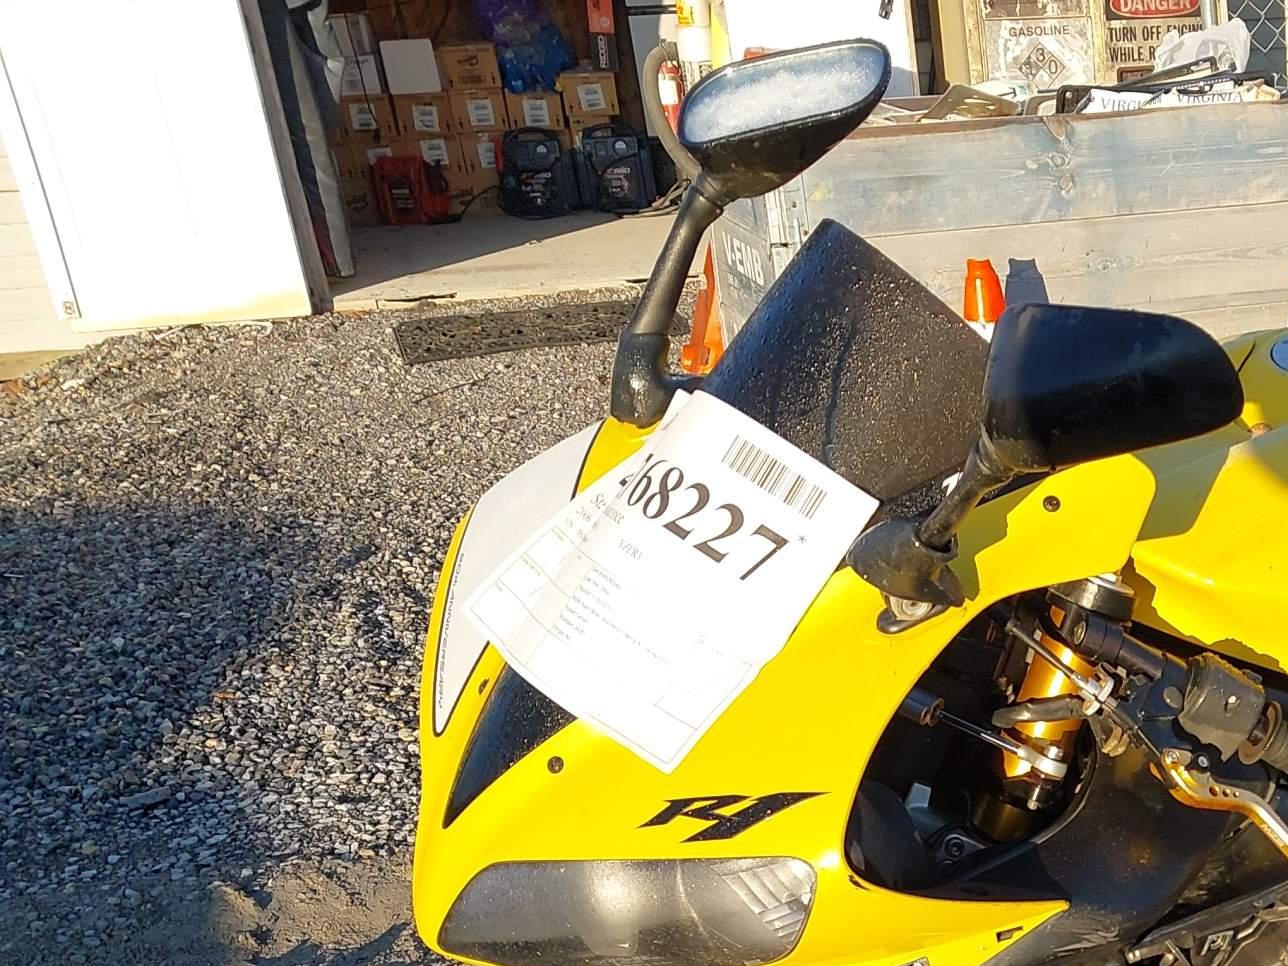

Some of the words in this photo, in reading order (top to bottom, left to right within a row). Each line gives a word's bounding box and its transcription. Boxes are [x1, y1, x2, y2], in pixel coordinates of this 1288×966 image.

[1120, 0, 1191, 12] DANGER
[1008, 25, 1070, 37] GASOLINE
[1108, 25, 1137, 42] TURN
[1142, 25, 1162, 41] OFF
[1035, 47, 1046, 63] 3
[1109, 45, 1144, 63] WHILE
[1048, 59, 1058, 75] 0
[635, 791, 834, 844] R1
